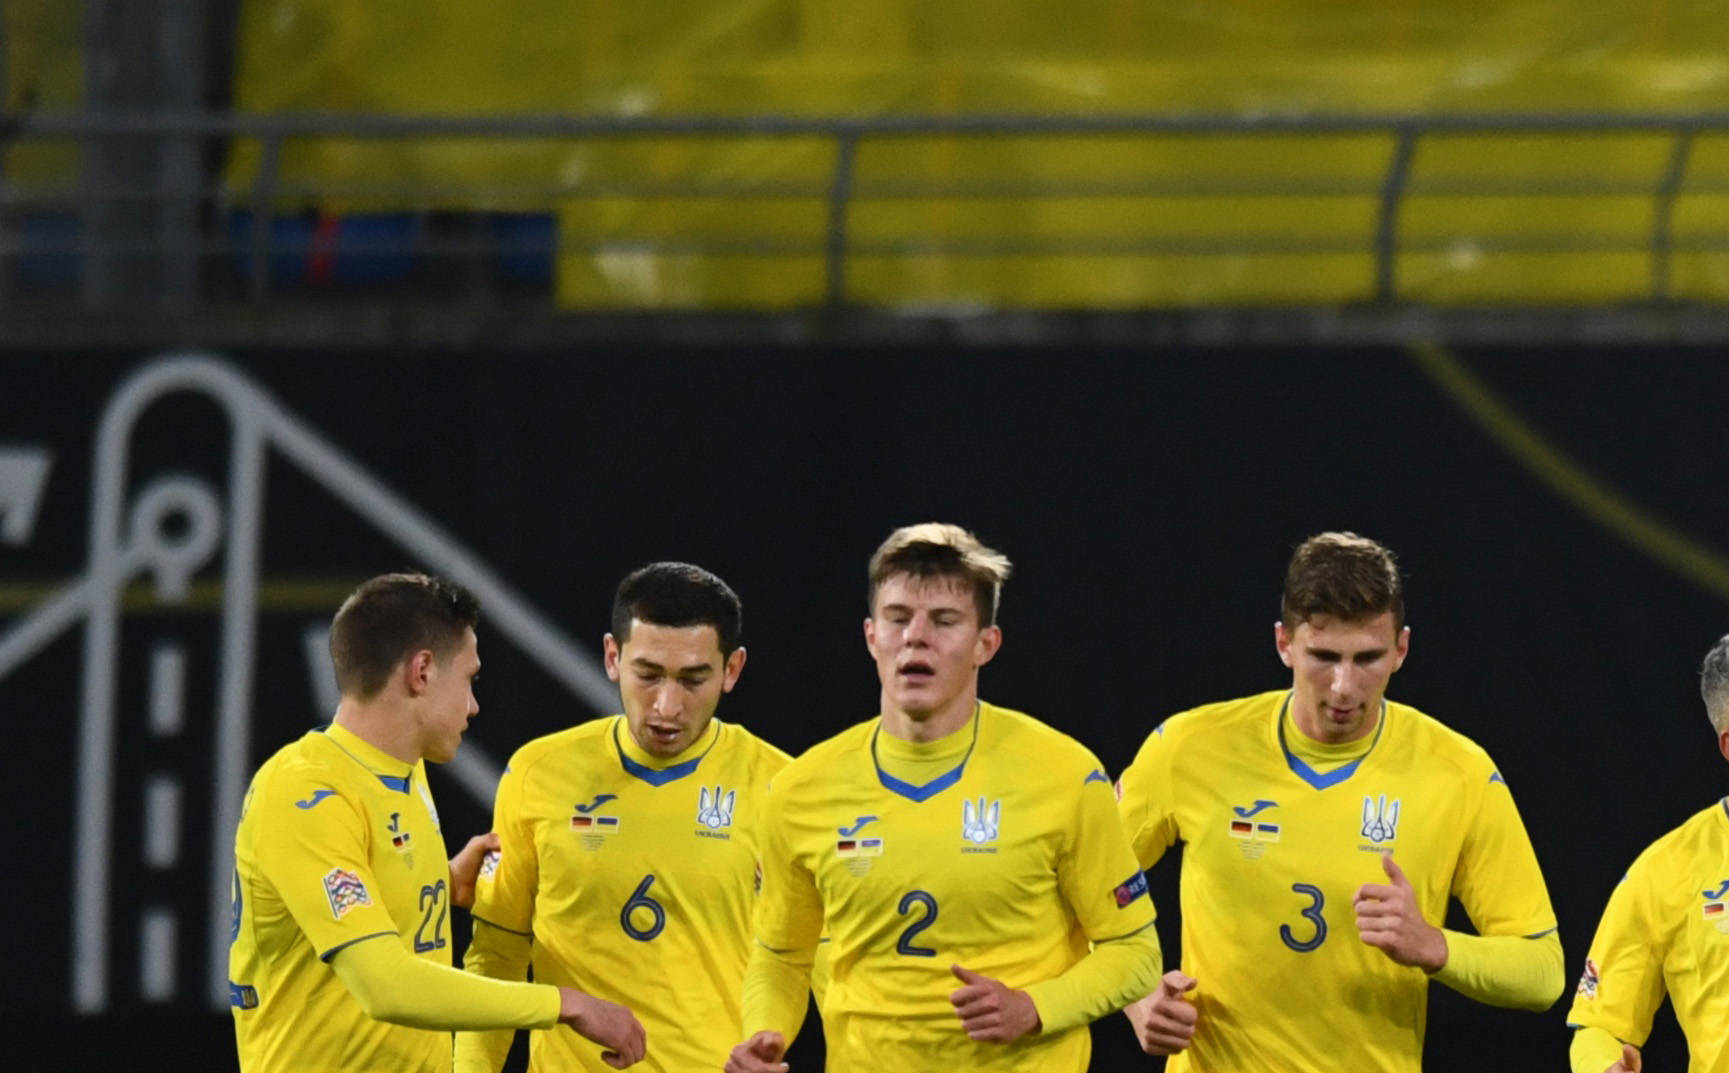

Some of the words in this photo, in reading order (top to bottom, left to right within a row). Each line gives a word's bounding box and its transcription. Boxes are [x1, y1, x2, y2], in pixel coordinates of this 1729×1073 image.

[413, 879, 446, 954] 22
[619, 873, 666, 942] 6
[896, 890, 939, 957] 2
[1279, 883, 1328, 953] 3
